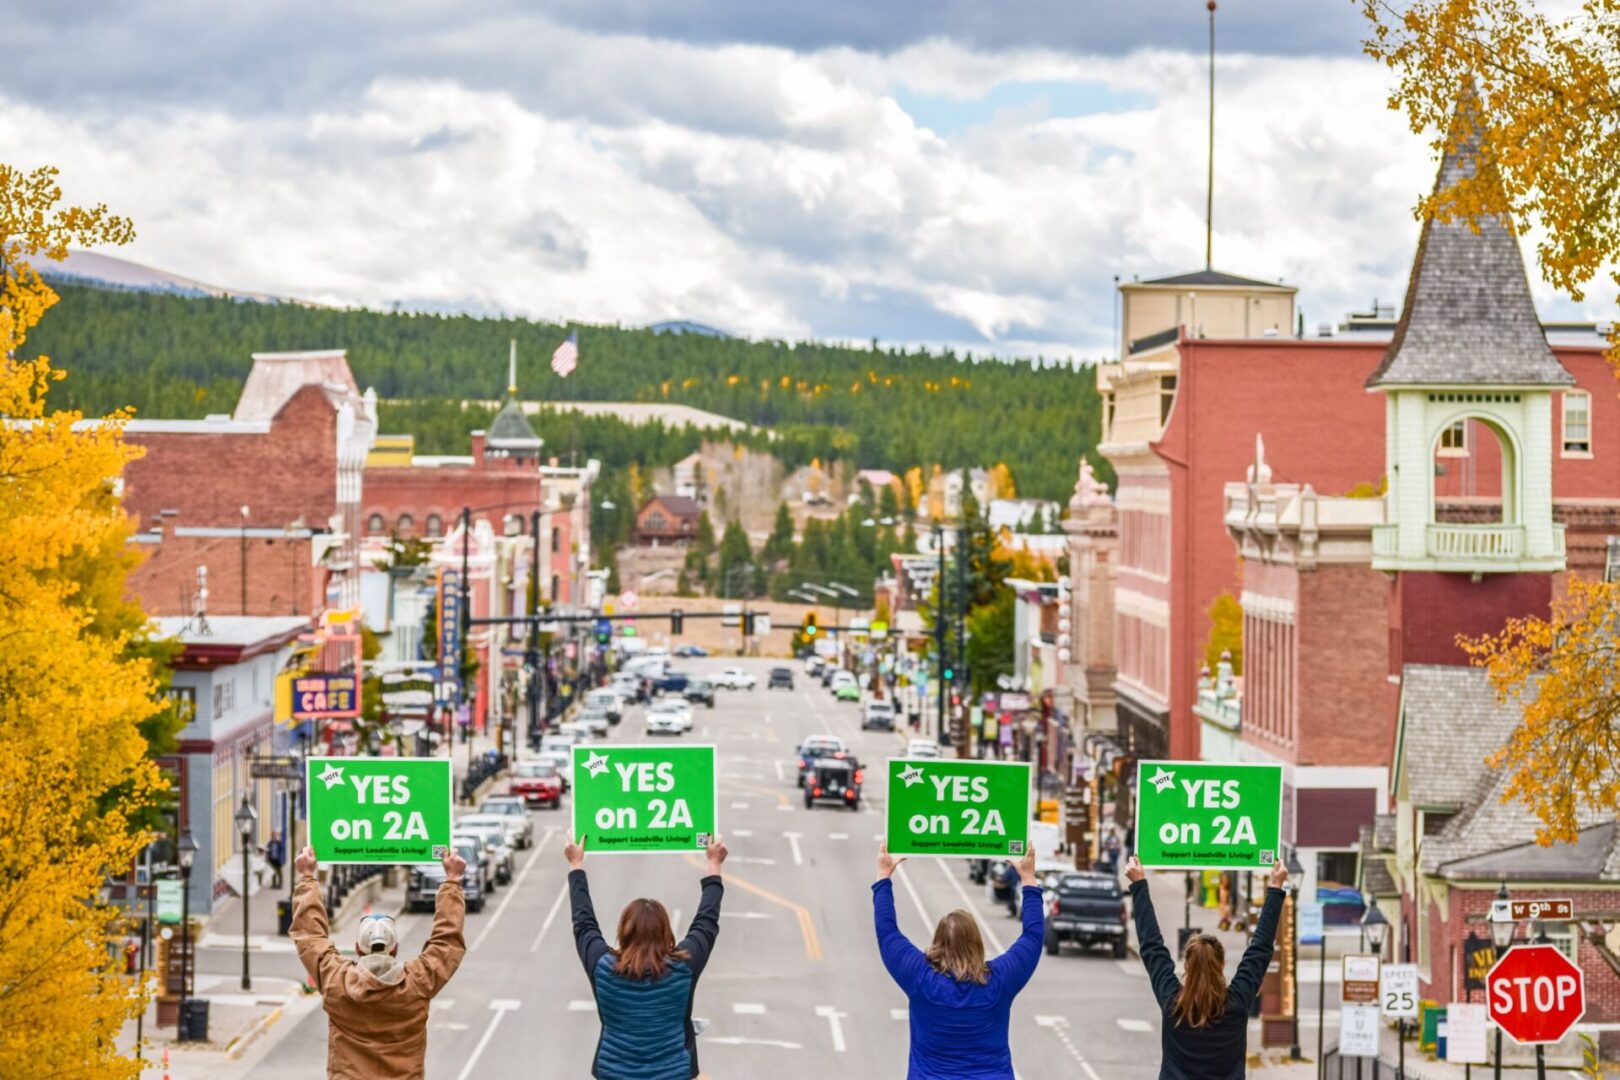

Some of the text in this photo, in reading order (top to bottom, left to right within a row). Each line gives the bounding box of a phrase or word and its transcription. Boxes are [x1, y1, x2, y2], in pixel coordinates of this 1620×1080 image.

[301, 691, 349, 711] CAFE
[588, 760, 603, 769] VOTE
[325, 771, 339, 782] VOTE
[614, 762, 675, 792] YES
[904, 771, 918, 780] VOTE
[1155, 776, 1170, 785] VOTE
[349, 774, 411, 805] YES
[929, 775, 989, 803] YES
[1180, 779, 1241, 809] YES
[595, 799, 694, 830] on 2A
[908, 808, 1006, 836] on 2A
[330, 811, 430, 840] on 2A
[1159, 815, 1257, 845] on 2A
[334, 847, 363, 855] Support
[401, 847, 426, 855] Living!
[1161, 851, 1191, 859] Support
[1229, 852, 1254, 860] Living!
[1513, 902, 1569, 918] W 9th St
[1385, 970, 1413, 978] SPEED
[1387, 981, 1411, 989] LIMIT
[1493, 975, 1577, 1014] STOP
[1386, 992, 1414, 1010] 25
